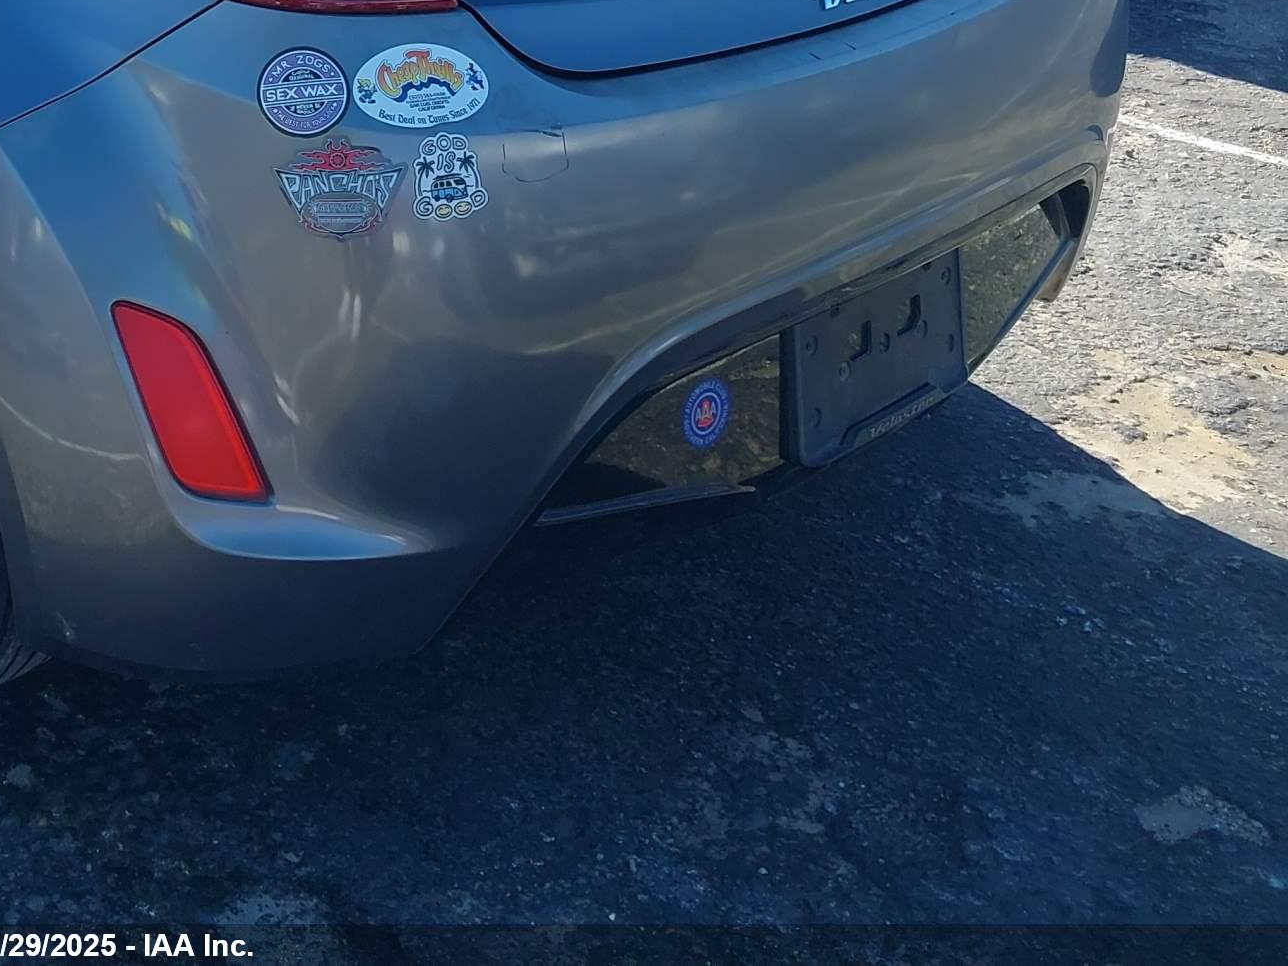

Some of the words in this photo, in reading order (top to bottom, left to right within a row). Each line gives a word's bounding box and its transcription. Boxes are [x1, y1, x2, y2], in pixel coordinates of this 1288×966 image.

[271, 60, 294, 78] MR
[295, 55, 331, 73] ZOGS
[376, 62, 418, 96] Cheap
[266, 87, 300, 102] SEX
[300, 84, 339, 98] WAX
[379, 109, 397, 122] Best
[398, 114, 416, 125] Deal
[450, 107, 469, 120] Since
[422, 135, 467, 155] GOD
[436, 151, 456, 173] IS
[278, 170, 400, 212] PANCHO'S
[694, 399, 717, 429] AAA
